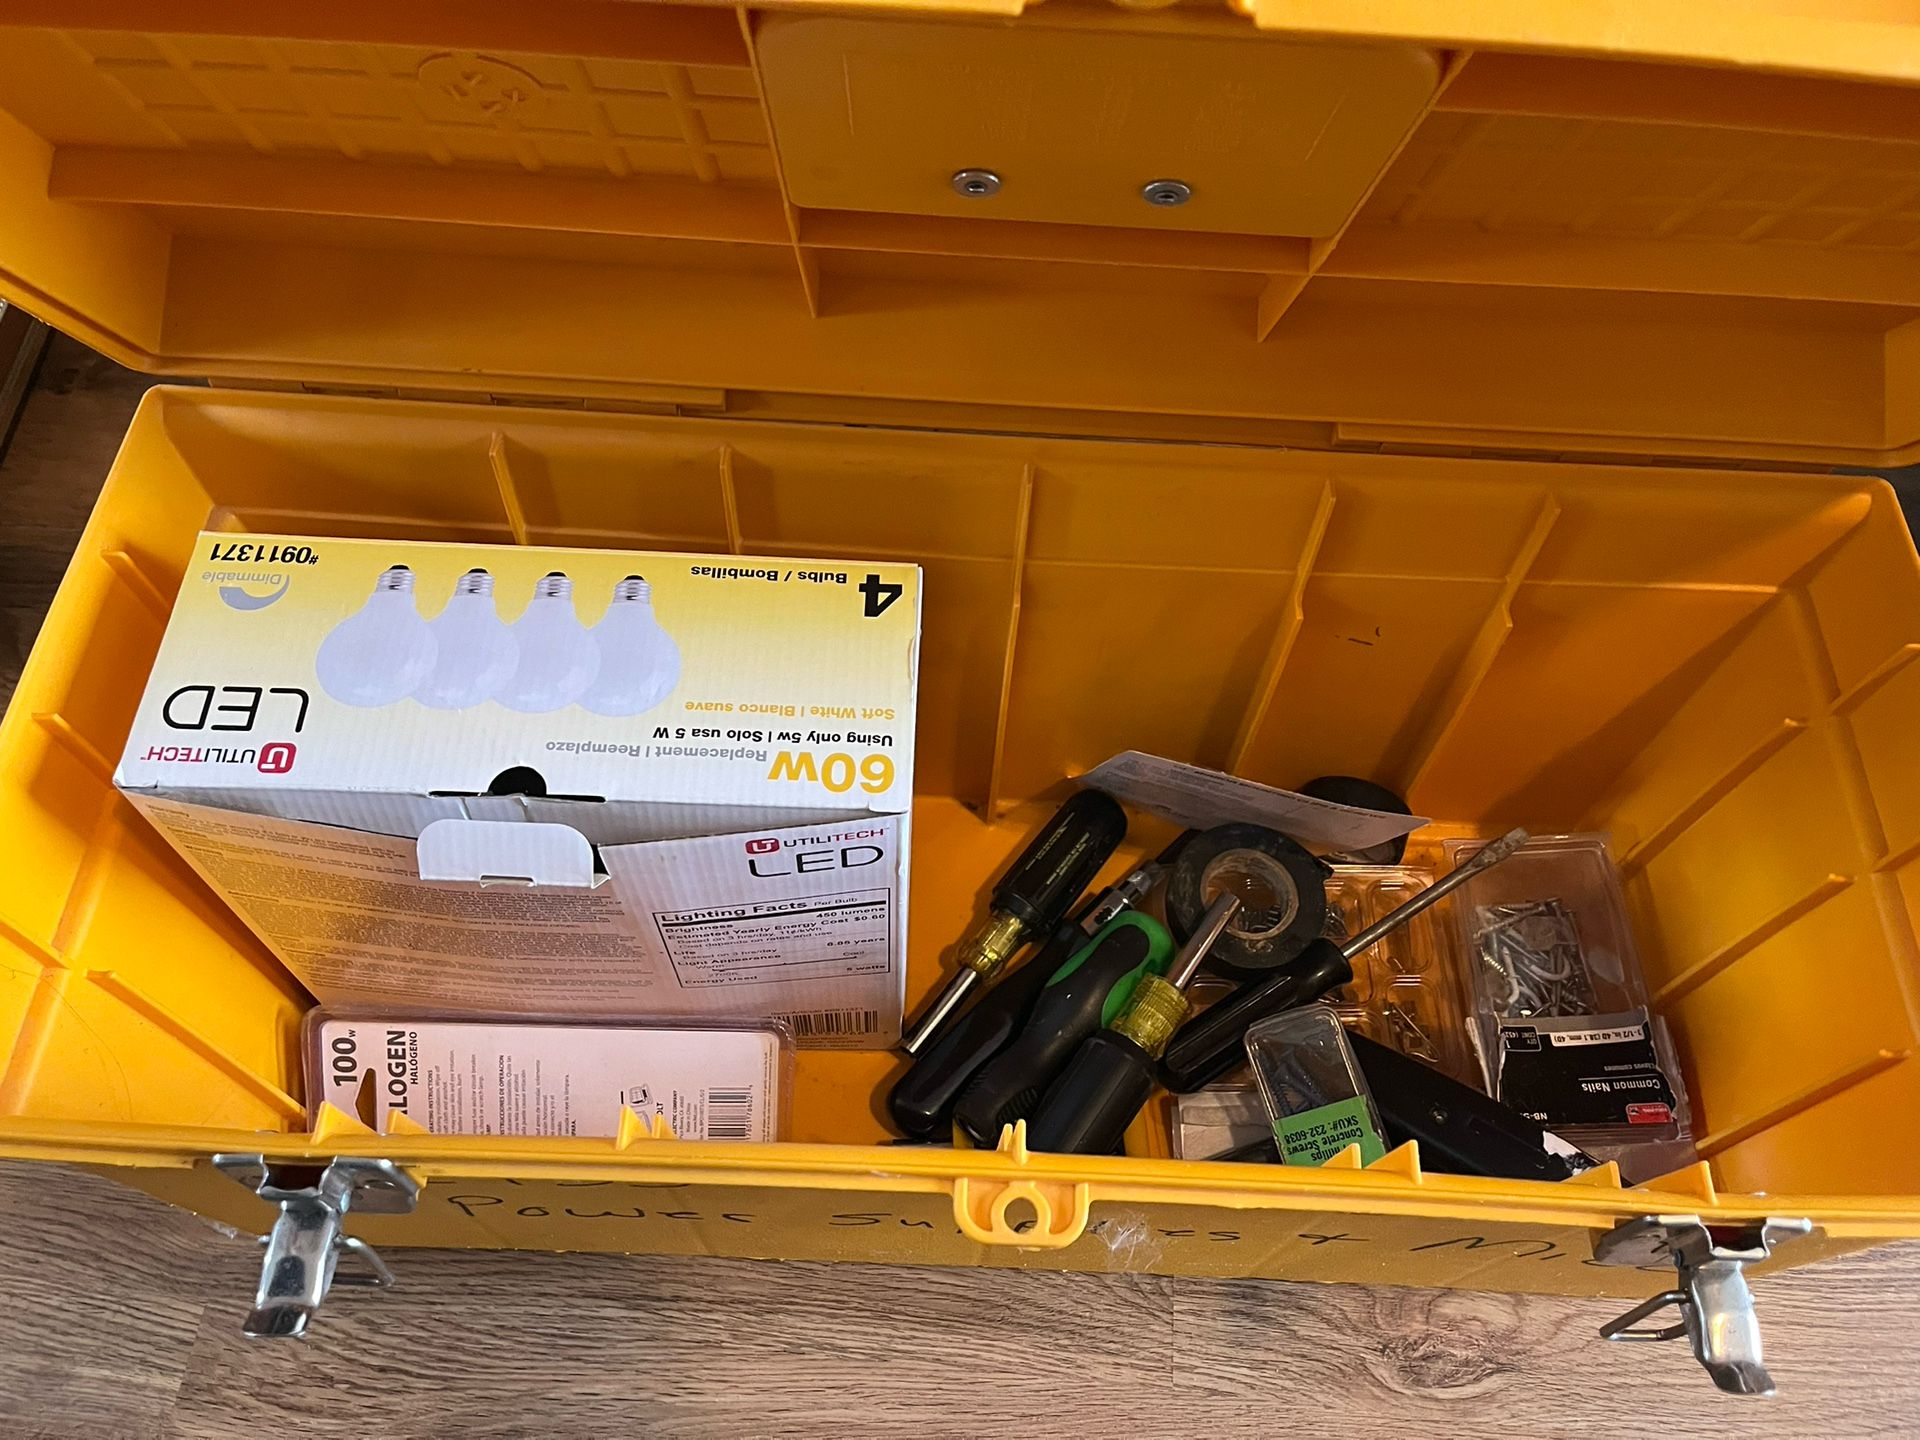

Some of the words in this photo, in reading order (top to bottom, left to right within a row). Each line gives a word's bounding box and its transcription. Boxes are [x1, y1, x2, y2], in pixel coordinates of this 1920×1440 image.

[210, 543, 319, 565] #0911371
[202, 571, 283, 585] Dimmable
[690, 565, 779, 582] Bombillas
[798, 571, 848, 584] Bulbs
[858, 574, 903, 617] 4
[162, 685, 310, 733] LED
[685, 701, 733, 713] suave
[738, 702, 796, 717] Blanco
[810, 705, 857, 719] White
[860, 707, 895, 720] Soft
[653, 726, 670, 739] W
[675, 727, 686, 739] 5
[691, 728, 721, 740] usa
[735, 729, 764, 742] Solo
[806, 730, 842, 745] only
[846, 731, 893, 747] Using
[147, 746, 256, 763] UTILITECH
[545, 740, 641, 757] Reemplazo
[655, 744, 767, 762] Replacement
[784, 828, 884, 847] UTILITECH
[748, 845, 884, 877] LED
[661, 909, 746, 922] Lighting
[753, 902, 808, 914] Facts
[841, 907, 886, 916] lumens
[665, 924, 734, 934] Brightness
[668, 930, 730, 940] Estimated
[733, 927, 771, 935] Yearly
[774, 922, 817, 931] Energy
[821, 918, 849, 926] Cost
[854, 936, 886, 945] years
[409, 1031, 418, 1085] HALÓGENO
[387, 1030, 408, 1115] LOGEN
[1581, 1082, 1611, 1093] Nails
[1613, 1079, 1661, 1090] Common
[1284, 1125, 1327, 1144] 232-6038
[1321, 1127, 1364, 1146] Concrete
[1287, 1140, 1320, 1155] Screws
